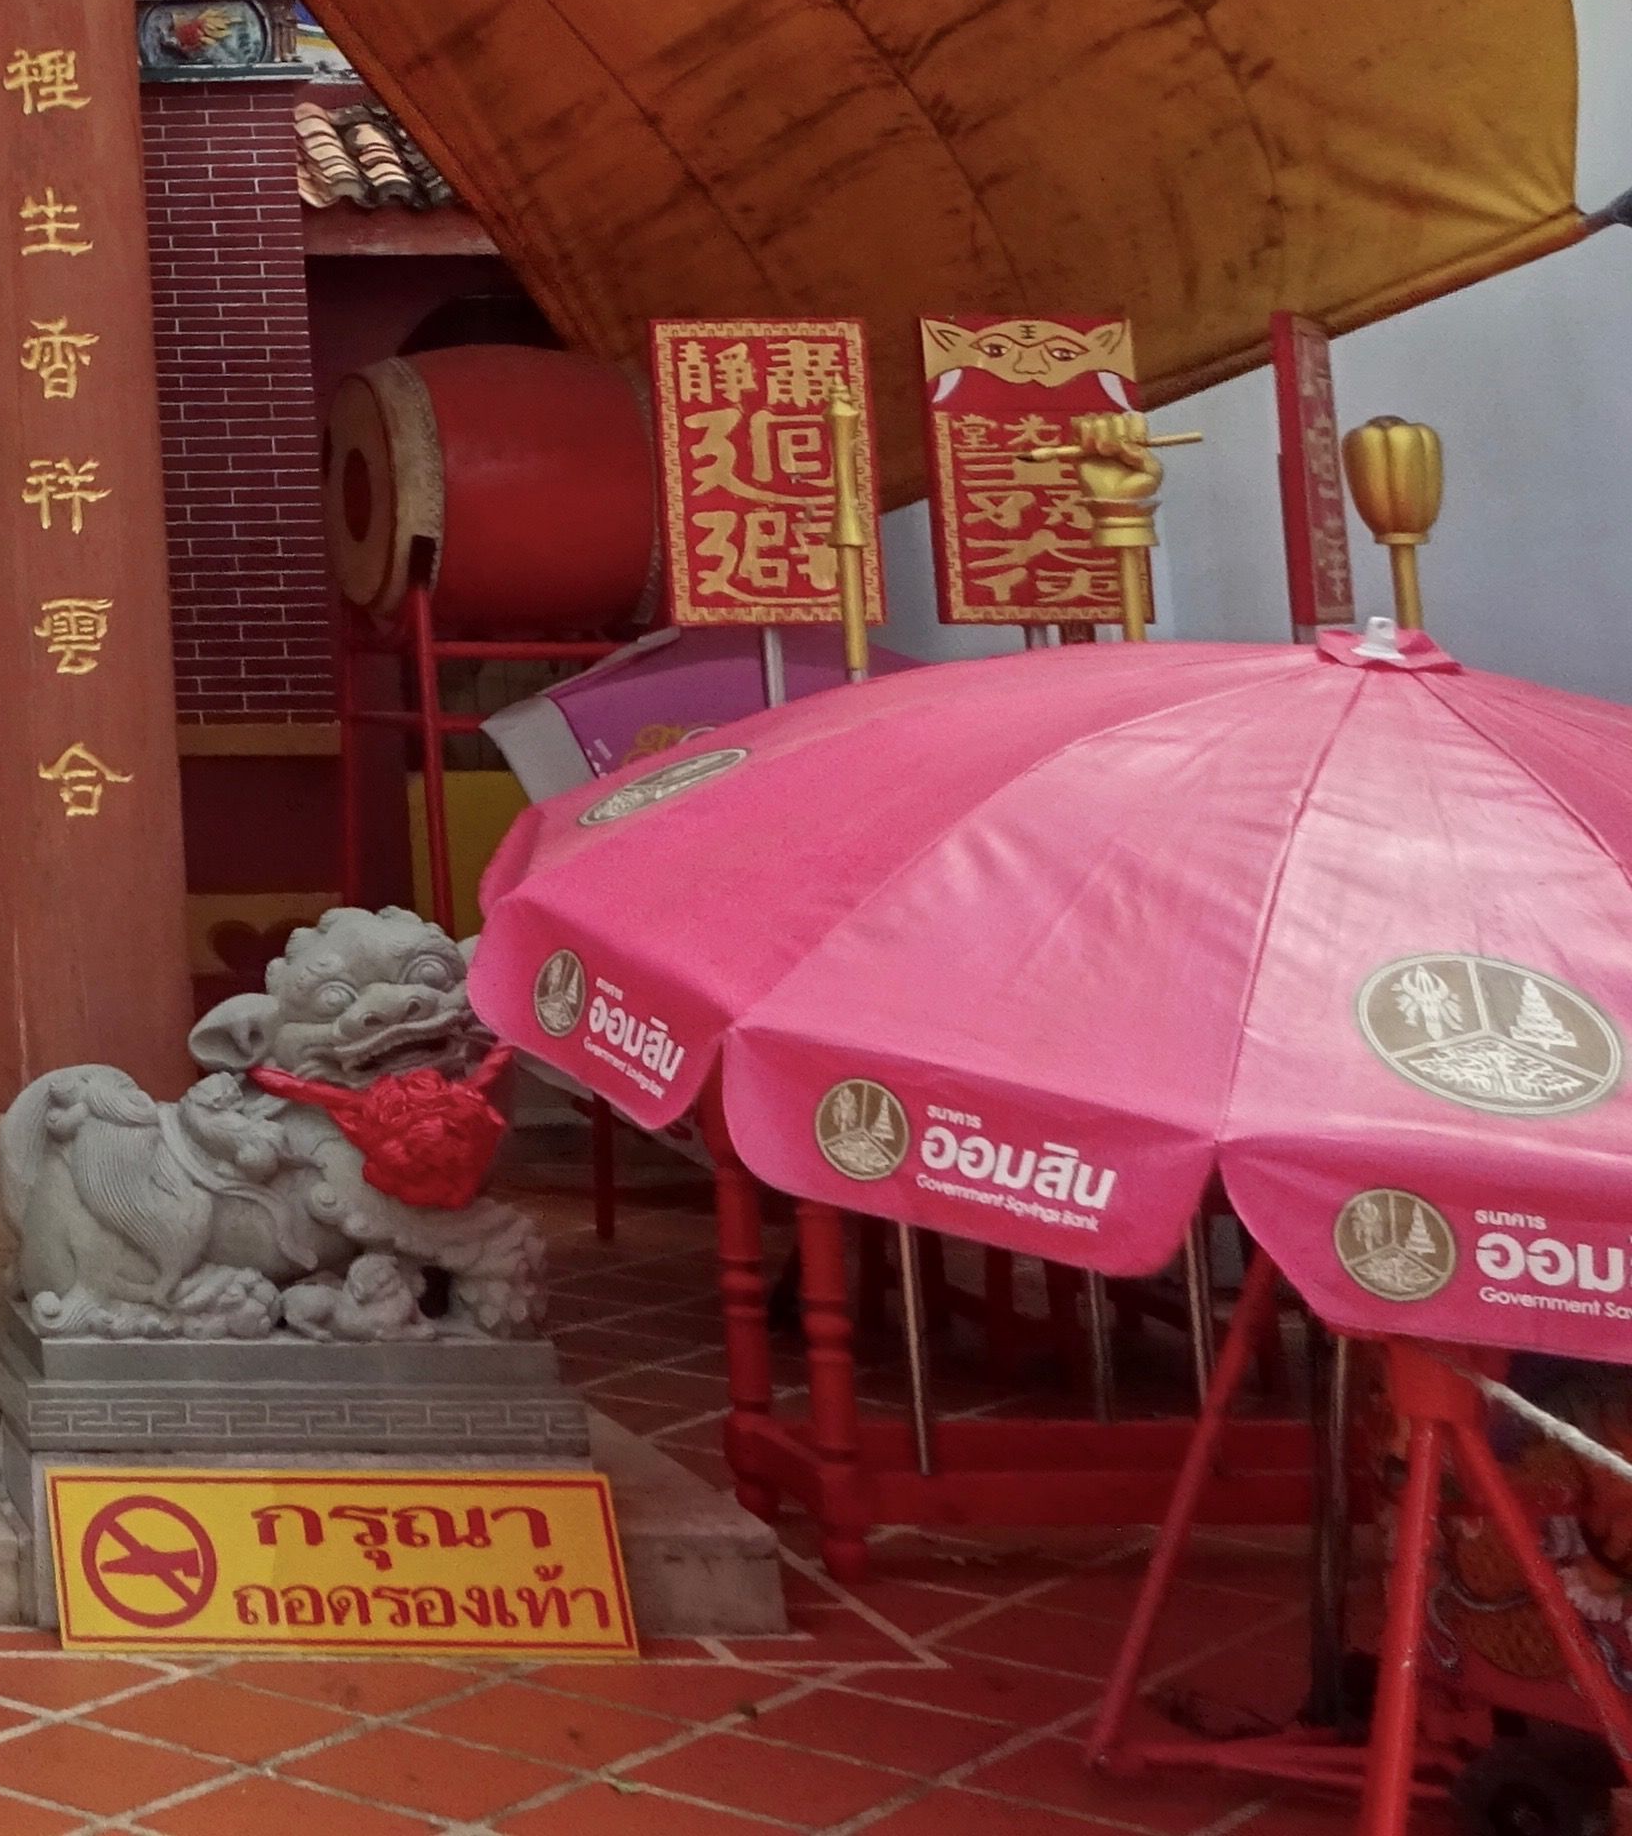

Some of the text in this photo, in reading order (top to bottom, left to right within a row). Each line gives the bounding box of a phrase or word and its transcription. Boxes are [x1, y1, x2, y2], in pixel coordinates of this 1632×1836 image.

[589, 995, 685, 1082] ออมสิน
[916, 1173, 1004, 1207] Government
[921, 1126, 1118, 1210] ออมสิน
[1474, 1209, 1548, 1231] ธนาคาร
[1475, 1232, 1632, 1294] ออม
[1479, 1286, 1601, 1316] Government
[250, 1504, 552, 1571] กรุณา
[232, 1563, 612, 1629] ถอดรองเท้า
